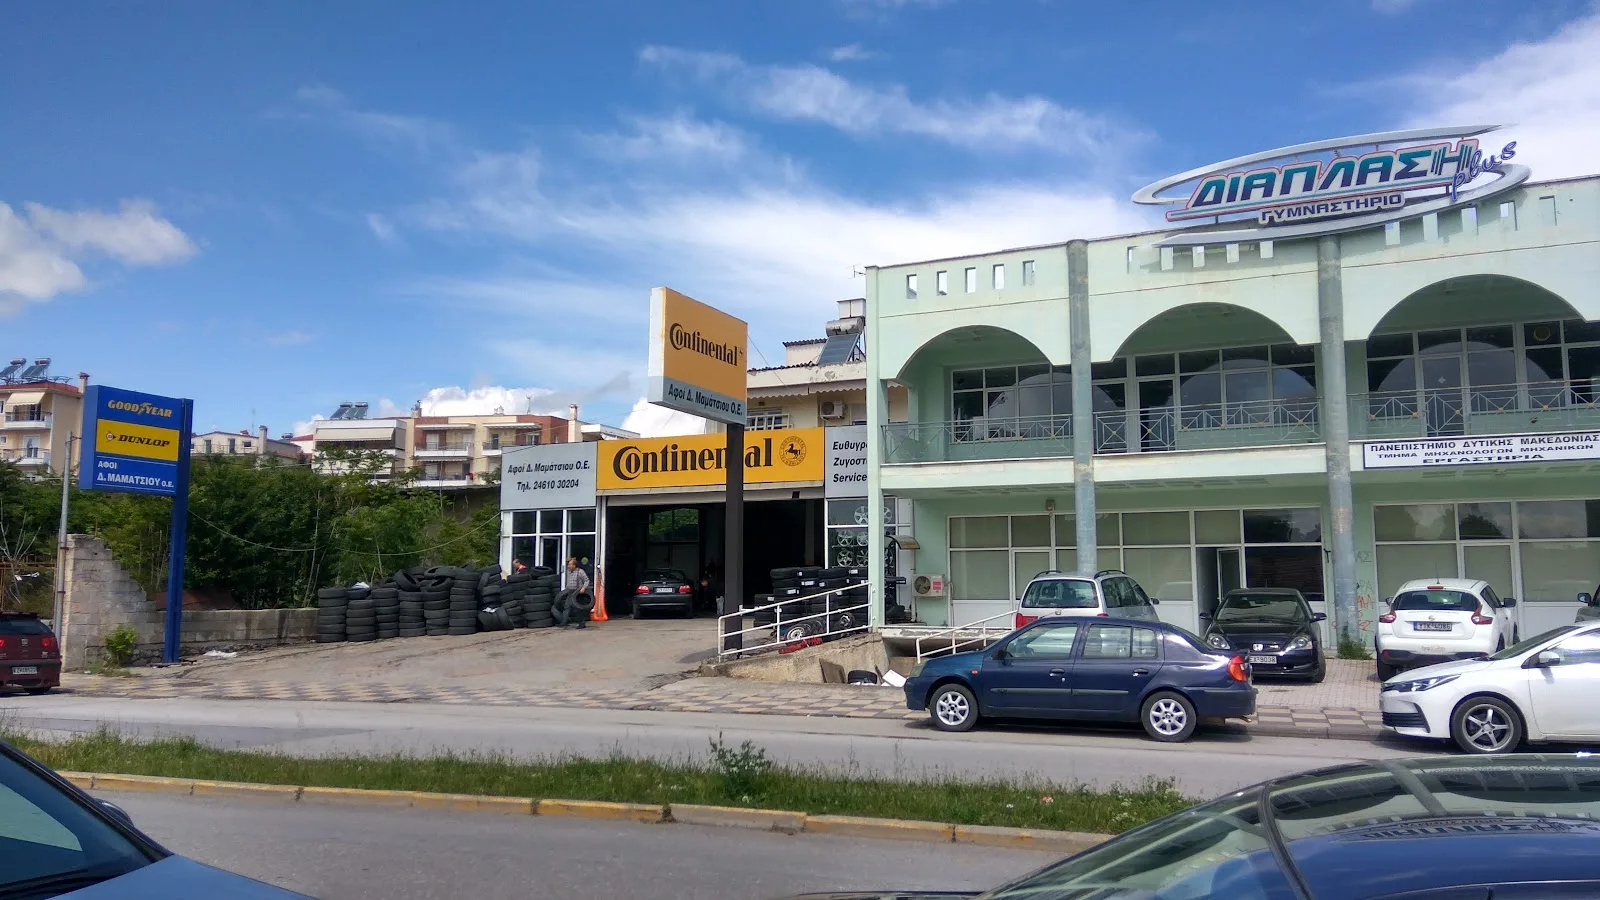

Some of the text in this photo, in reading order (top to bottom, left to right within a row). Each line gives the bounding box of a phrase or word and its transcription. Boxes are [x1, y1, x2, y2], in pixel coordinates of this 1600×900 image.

[1191, 144, 1472, 207] ΔΙΑΠΛΑΣΗ
[1451, 141, 1517, 202] plus
[1262, 194, 1401, 221] ΓΥΜΝΑΣΤΗΡΙΟ
[669, 322, 738, 367] Continental
[118, 434, 170, 447] DUNLOP
[832, 440, 868, 451] Ευθυγρ
[1370, 434, 1600, 452] ΠΑΝΕΠΙΣΤΗΜΙΟ ΔΥΤΙΚΗΣ ΜΑΚΕΔΟΝΙΑΣ
[1424, 448, 1513, 457] ΜΗΧΑΝΟΛΟΓΩΝ
[1520, 444, 1594, 453] ΜΗΧΑΝΙΚΩΝ
[97, 460, 117, 469] ΑΦΟΙ
[612, 437, 773, 481] Continenal
[833, 457, 868, 468] Ζυγοστ
[1423, 454, 1545, 464] ΕΡΓΑΣΤΗΡΙΑ
[526, 463, 533, 473] Δ.
[575, 460, 590, 470] Ο.Ε.
[97, 472, 107, 481] Δ.
[107, 473, 161, 487] ΜΑΜΑΤΣΙΟΥ
[833, 472, 868, 483] Service
[517, 479, 579, 492] Τηλ. 24610 30204
